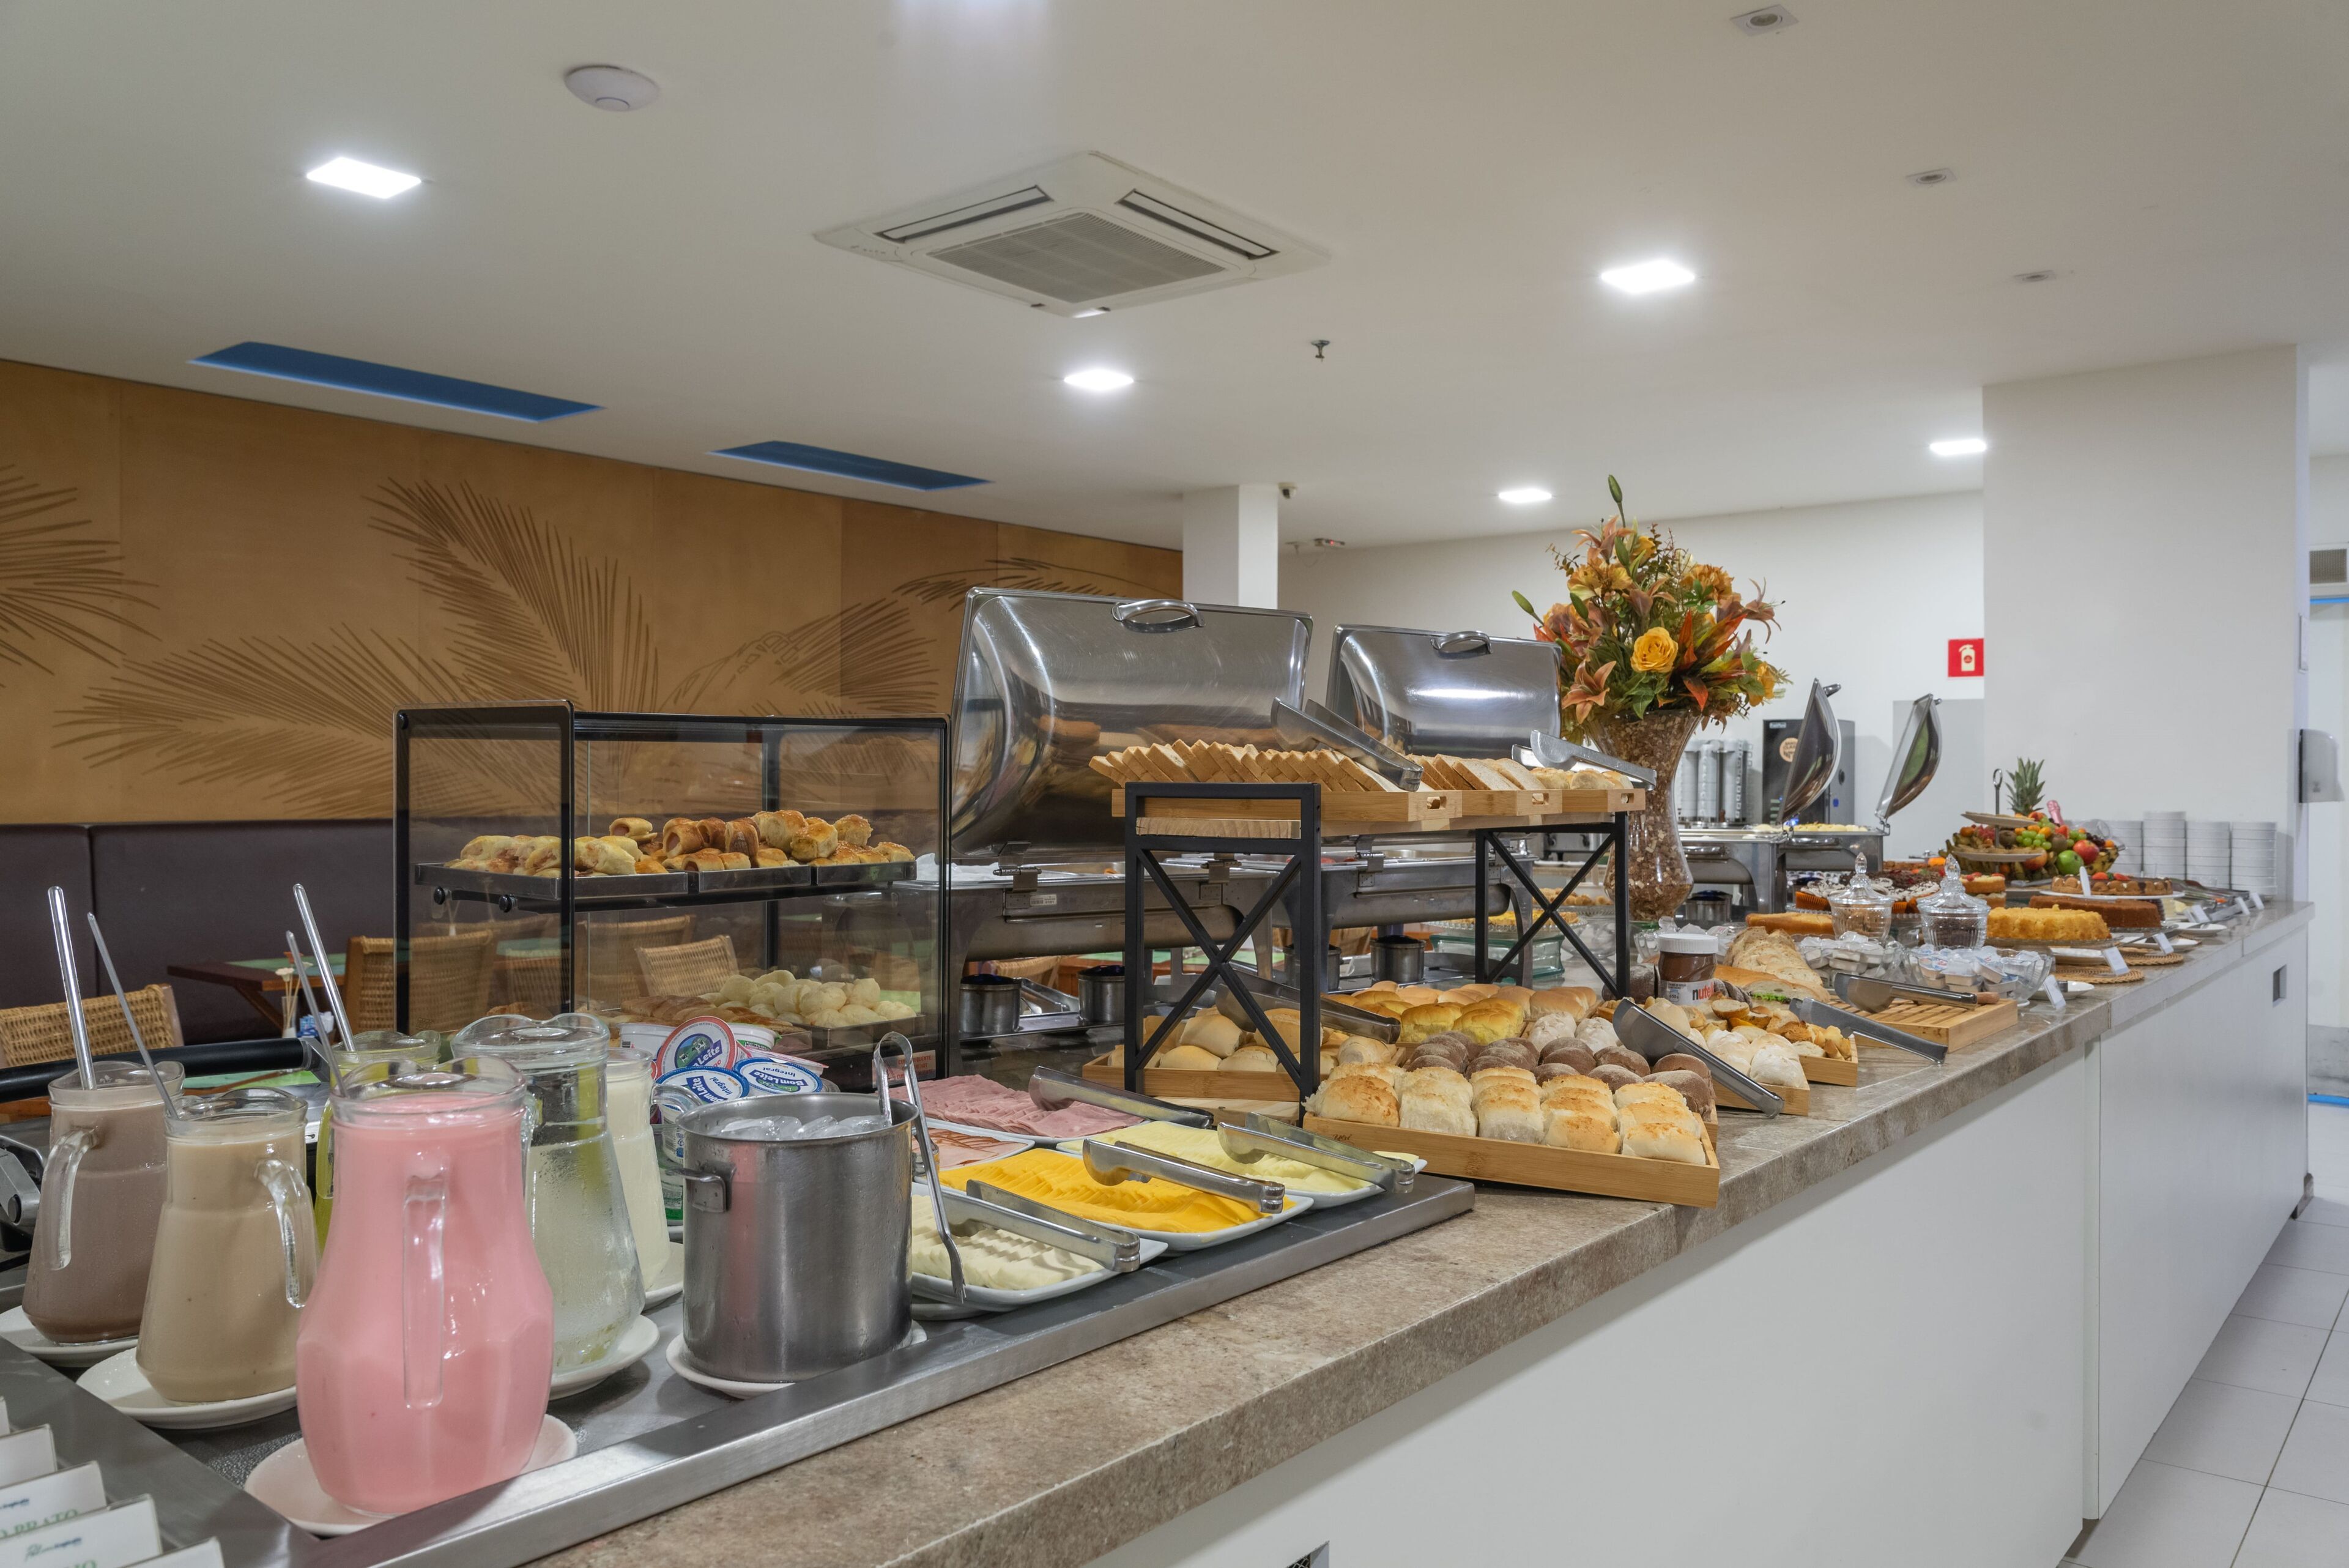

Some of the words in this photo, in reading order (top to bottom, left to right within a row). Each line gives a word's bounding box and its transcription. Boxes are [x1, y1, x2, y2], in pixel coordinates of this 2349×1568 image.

[1693, 982, 1714, 1000] nutel
[763, 1067, 795, 1077] Integral
[710, 1077, 733, 1096] Integral
